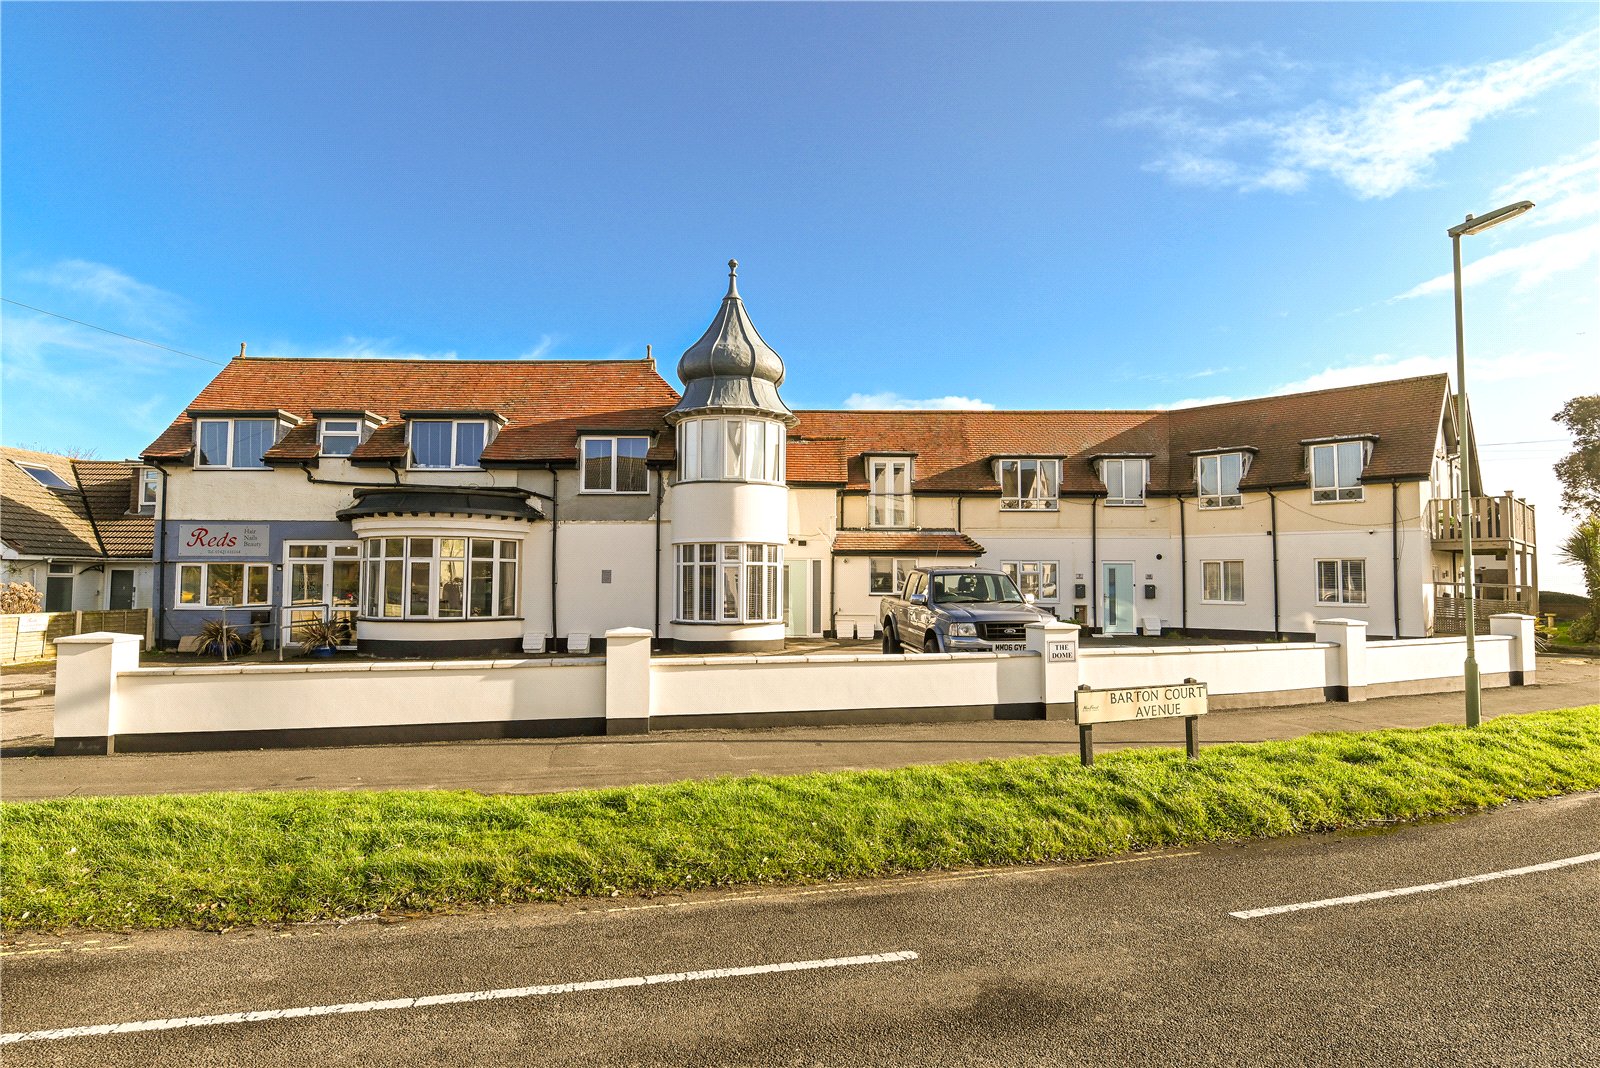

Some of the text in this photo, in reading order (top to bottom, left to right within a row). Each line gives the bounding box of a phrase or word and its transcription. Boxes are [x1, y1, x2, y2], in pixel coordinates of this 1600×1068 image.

[186, 527, 237, 547] Reds
[1110, 686, 1204, 704] BARTON COURT
[1135, 703, 1181, 718] AVENUE
